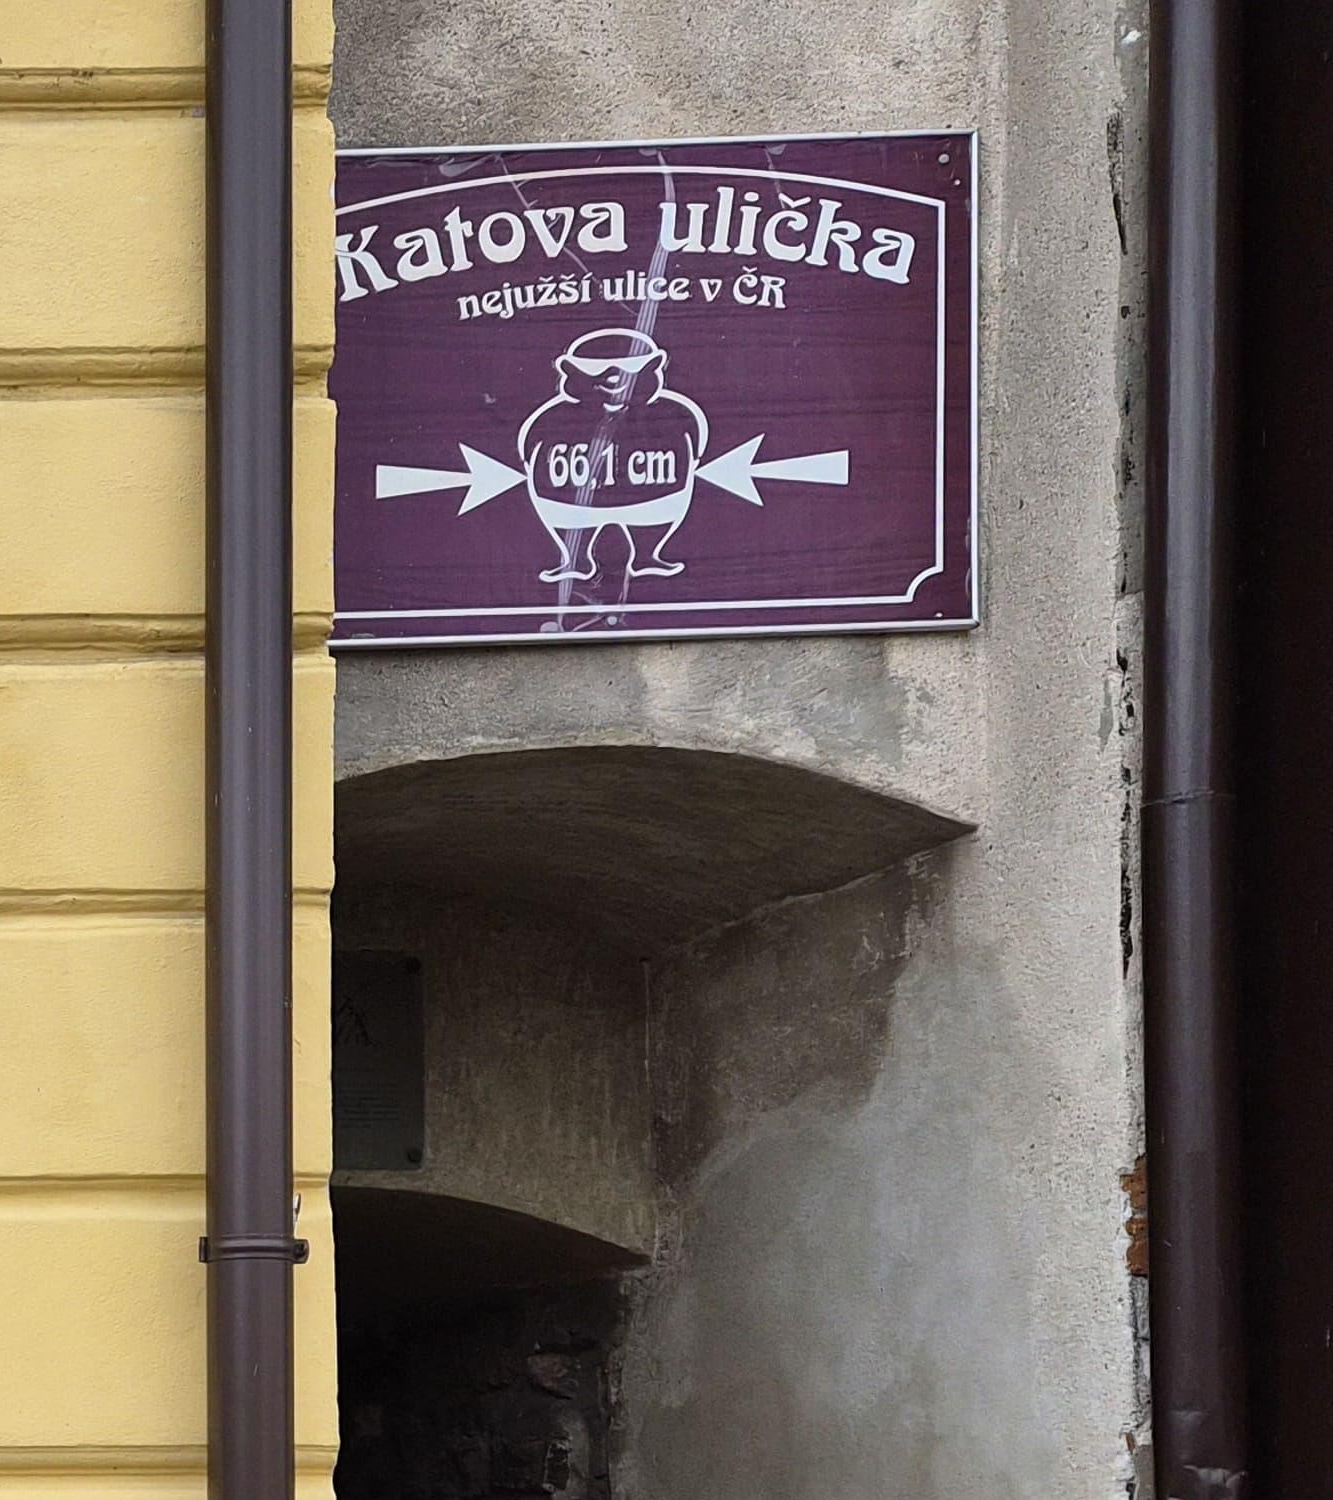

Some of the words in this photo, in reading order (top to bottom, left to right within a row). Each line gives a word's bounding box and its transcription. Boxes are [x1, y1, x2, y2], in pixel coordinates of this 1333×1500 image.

[335, 201, 629, 303] Katova
[658, 185, 918, 285] ulička
[456, 271, 594, 322] nejužší
[601, 268, 693, 305] ulice
[699, 275, 723, 304] v
[731, 265, 788, 311] ČR
[548, 442, 618, 490] 66,1
[626, 448, 679, 487] cm
